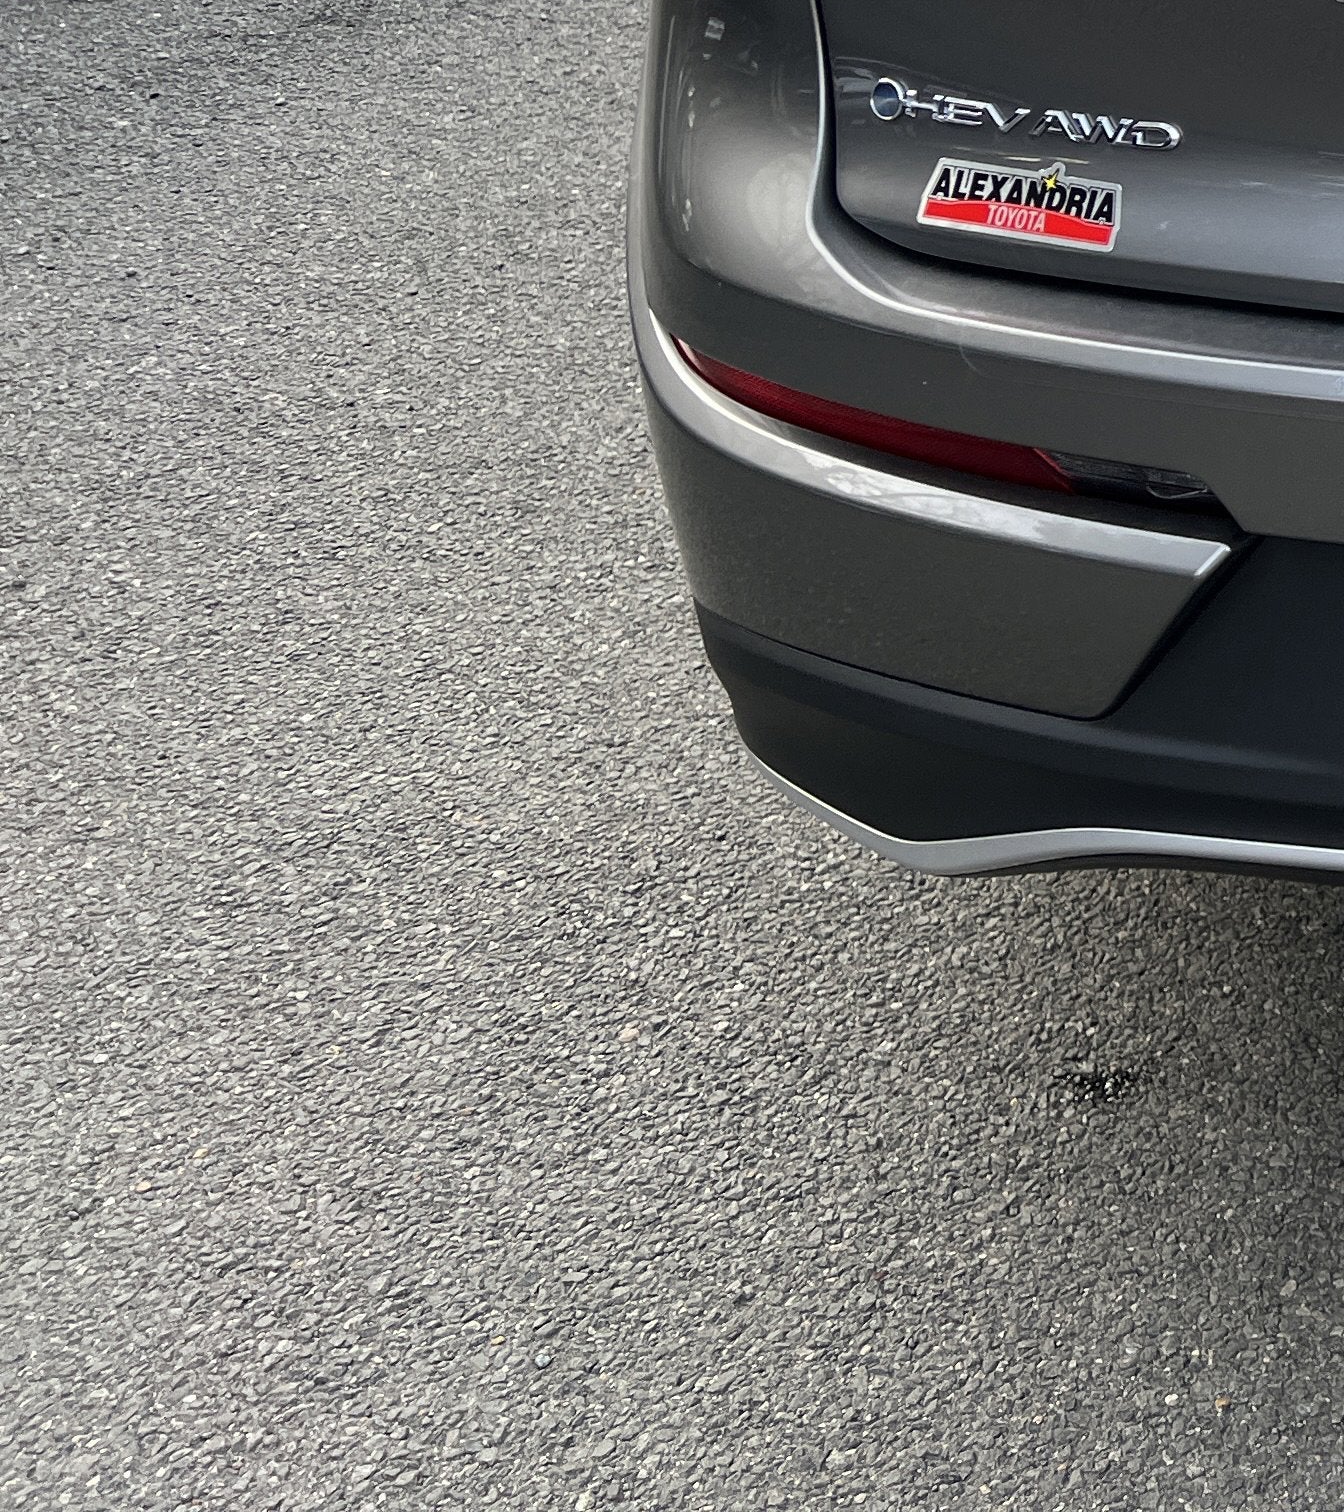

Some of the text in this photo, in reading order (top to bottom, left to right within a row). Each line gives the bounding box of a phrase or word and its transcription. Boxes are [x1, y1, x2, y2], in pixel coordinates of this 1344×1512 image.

[1029, 108, 1184, 152] AWD
[929, 166, 1116, 225] ALEXANDRIA
[985, 203, 1047, 234] TOYOTA
